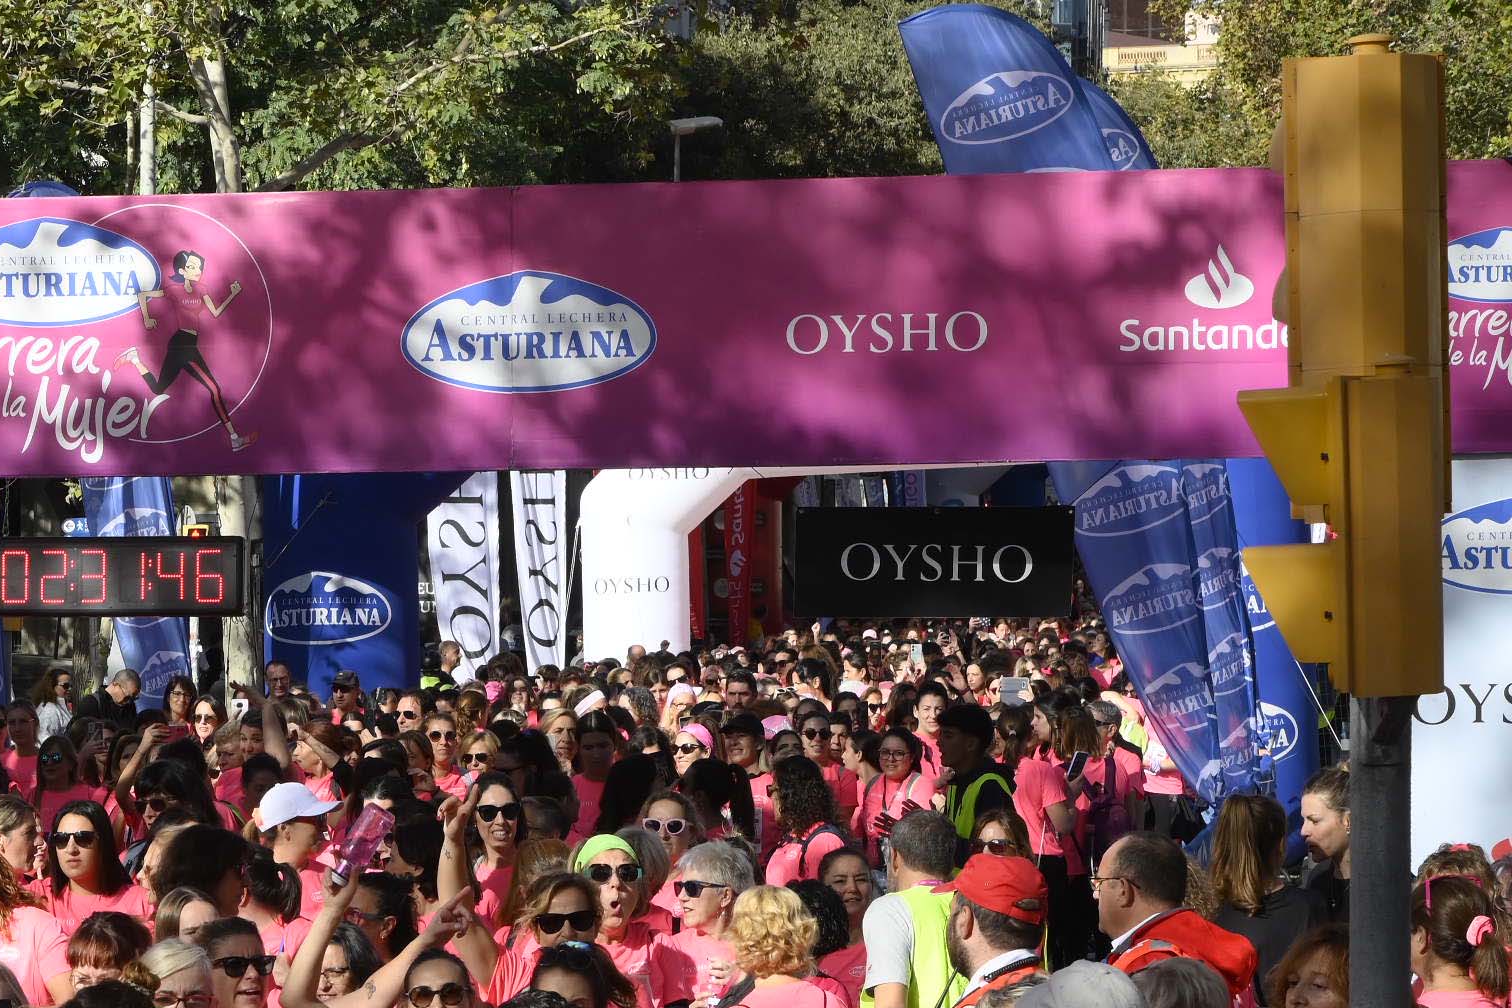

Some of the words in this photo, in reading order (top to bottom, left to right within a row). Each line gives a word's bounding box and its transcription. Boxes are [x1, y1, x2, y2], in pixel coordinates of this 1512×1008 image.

[64, 254, 136, 265] LECHERA
[461, 312, 538, 328] CENTRAL
[548, 312, 628, 324] LECHERA
[786, 311, 989, 355] OYSHO
[421, 319, 636, 363] ASTURIANA
[1469, 337, 1487, 366] la
[2, 380, 26, 418] la
[21, 369, 170, 464] Mujer
[841, 542, 1034, 583] OYSHO
[594, 576, 670, 595] OYSHO
[269, 600, 382, 628] ASTURIANA
